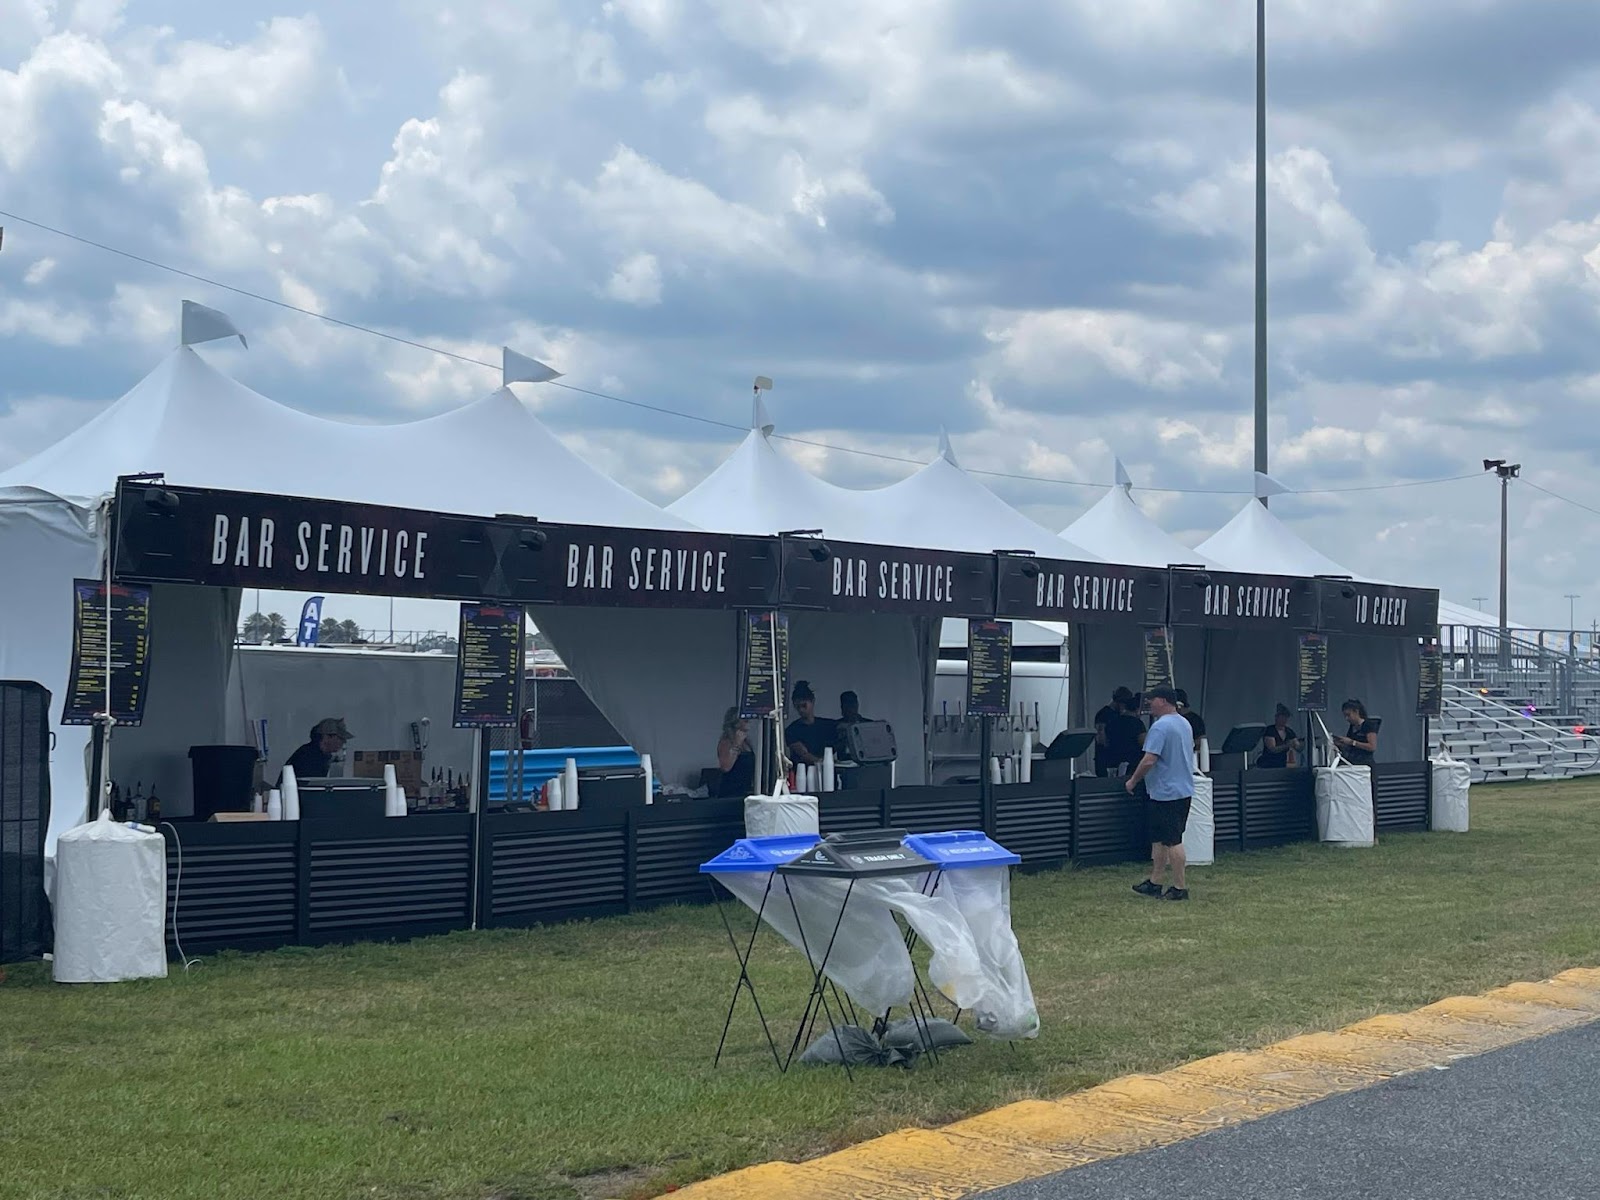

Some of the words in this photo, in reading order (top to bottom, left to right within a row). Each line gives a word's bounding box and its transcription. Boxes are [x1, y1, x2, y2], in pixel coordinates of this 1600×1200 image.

[212, 514, 275, 568] BAR
[295, 521, 428, 579] SERVICE
[567, 544, 613, 589] BAR
[628, 547, 727, 592] SERVICE
[832, 557, 867, 597] BAR
[878, 560, 953, 602] SERVICE
[1036, 572, 1065, 608] BAR
[1072, 575, 1134, 612] SERVICE
[1204, 584, 1230, 615] BAR
[1236, 585, 1291, 617] SERVICE
[1355, 595, 1368, 624] ID
[1372, 596, 1407, 626] CHECK
[863, 854, 889, 862] TRASH
